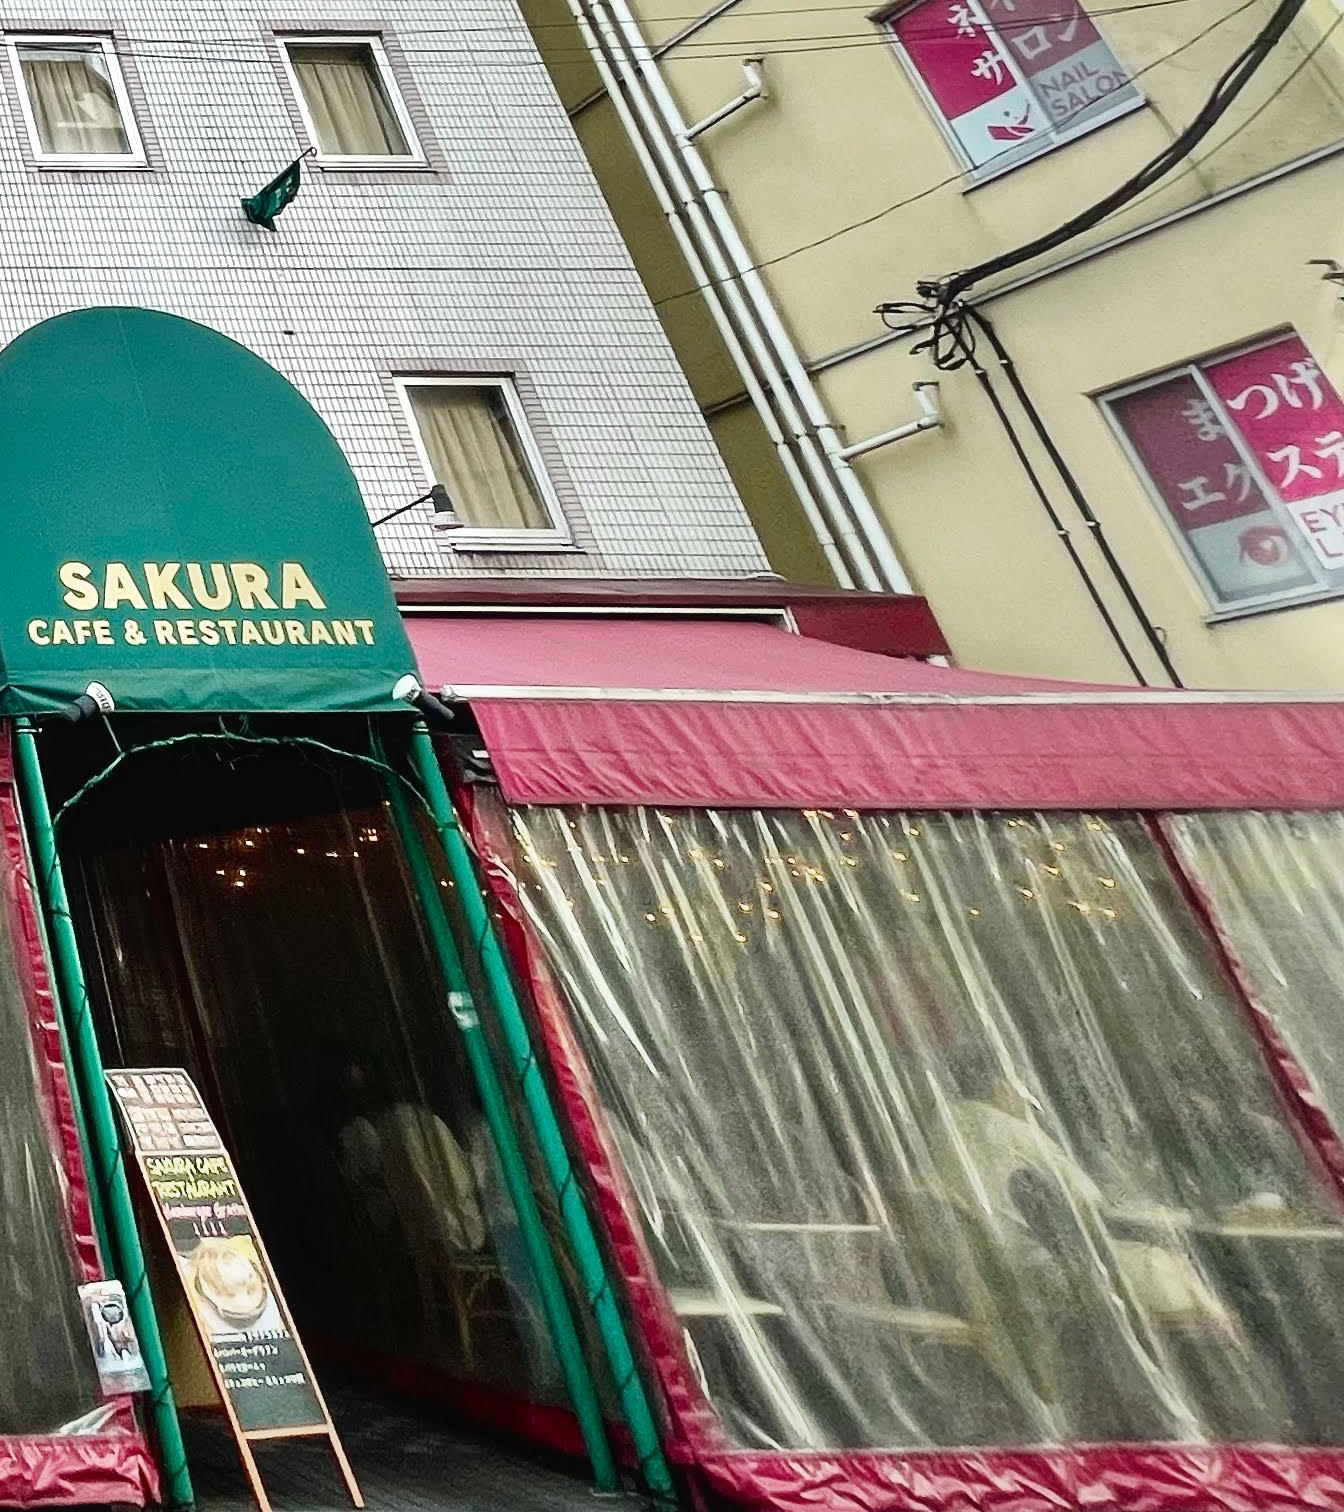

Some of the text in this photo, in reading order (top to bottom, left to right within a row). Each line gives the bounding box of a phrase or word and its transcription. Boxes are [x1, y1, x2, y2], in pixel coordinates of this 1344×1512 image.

[1039, 61, 1100, 98] NAIL
[1180, 356, 1323, 442] まつげ
[59, 562, 327, 610] SAKURA
[28, 619, 374, 646] CAFE & RESTAURANT
